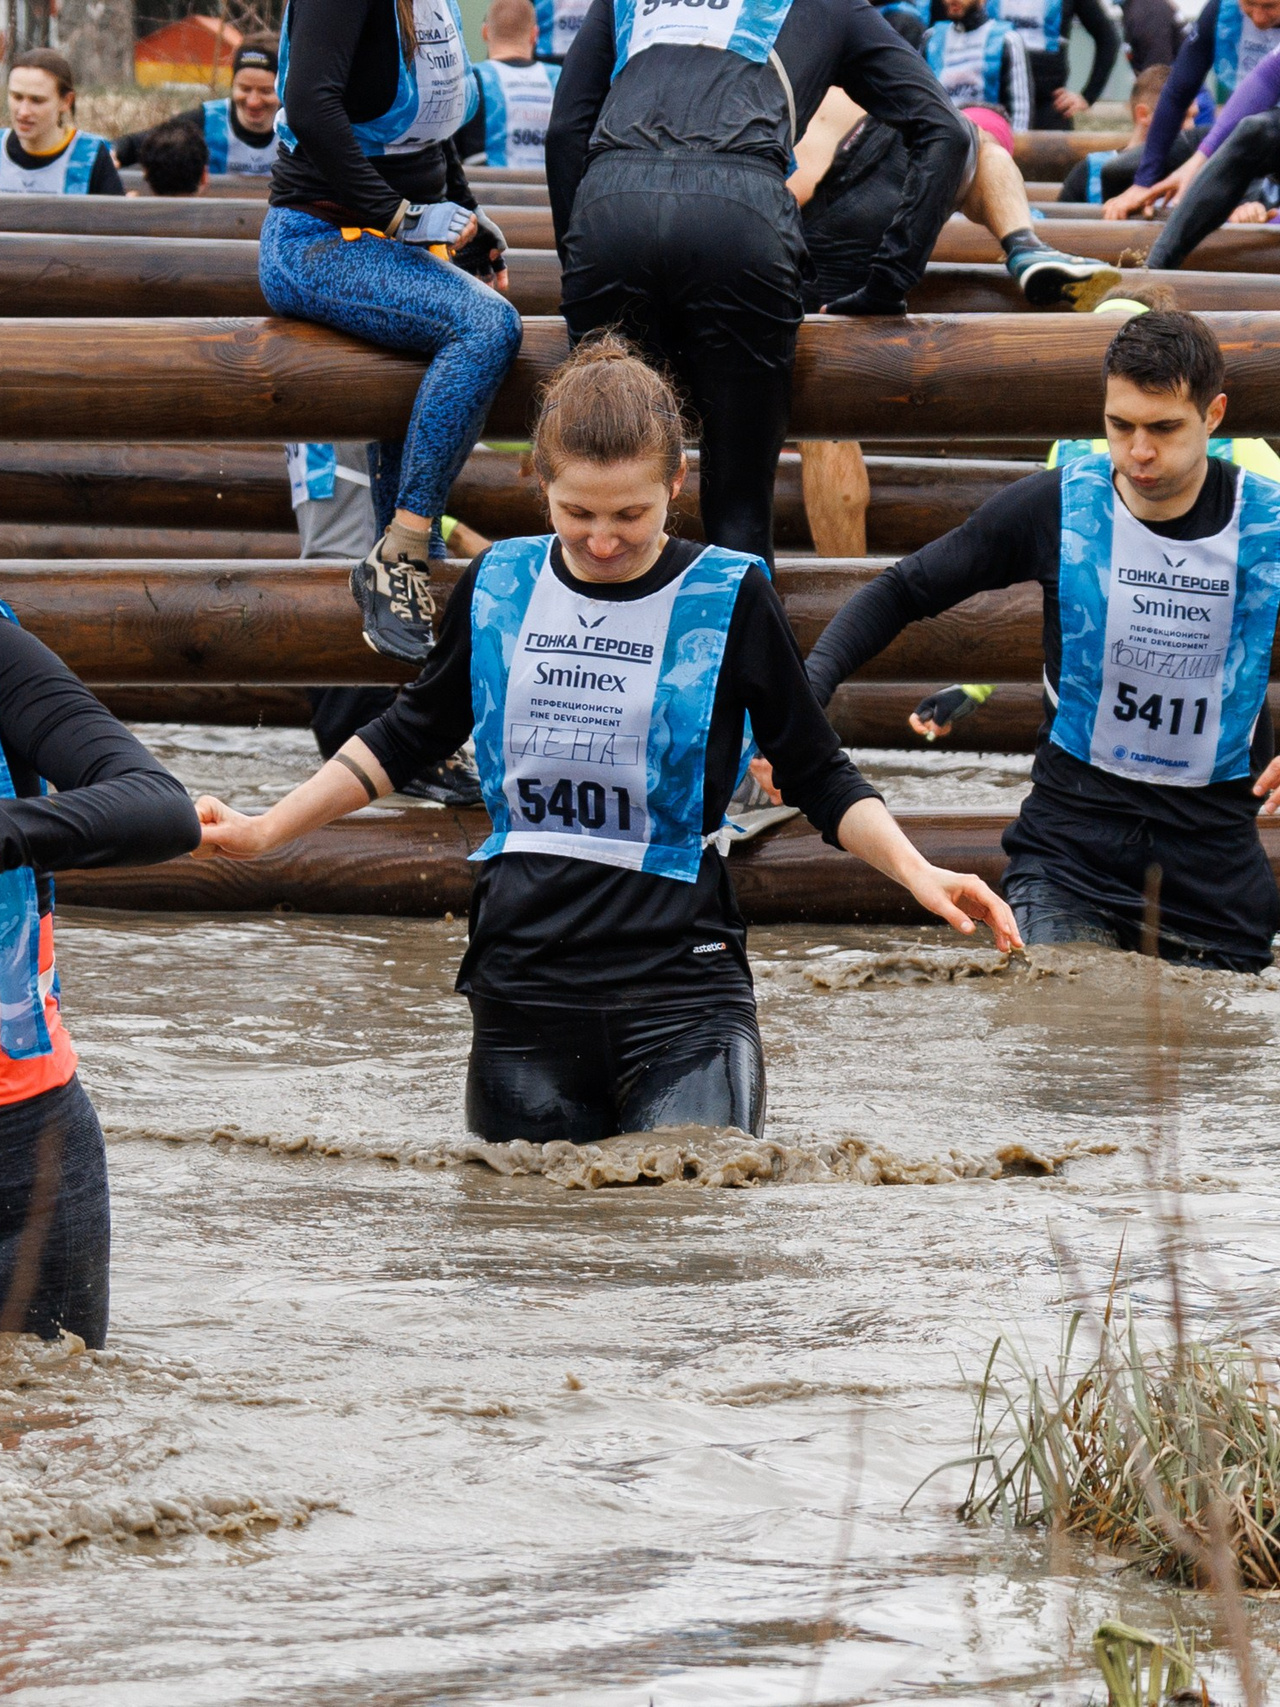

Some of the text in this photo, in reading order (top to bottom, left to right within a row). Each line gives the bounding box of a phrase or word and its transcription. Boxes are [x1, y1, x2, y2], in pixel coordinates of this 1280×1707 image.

[1118, 567, 1230, 592] ГОНКА ГЕРОЕВ
[1132, 593, 1211, 622] Sminex
[1129, 635, 1208, 650] FINE DEVELOPMENT
[1130, 624, 1210, 640] ПЕРФЕКЦИОНИСТЫ
[526, 632, 654, 658] ГОНКА ГЕРОЕВ
[533, 661, 627, 693] Sminex
[530, 698, 623, 715] ПЕРФЕКЦИОНИСТЫ
[530, 711, 621, 727] FINE DEVELOPMENT
[1113, 681, 1208, 735] 5411
[520, 725, 619, 767] ЛЕНА
[1130, 751, 1189, 768] ГАЗПРОМБАНК
[517, 778, 632, 831] 5401
